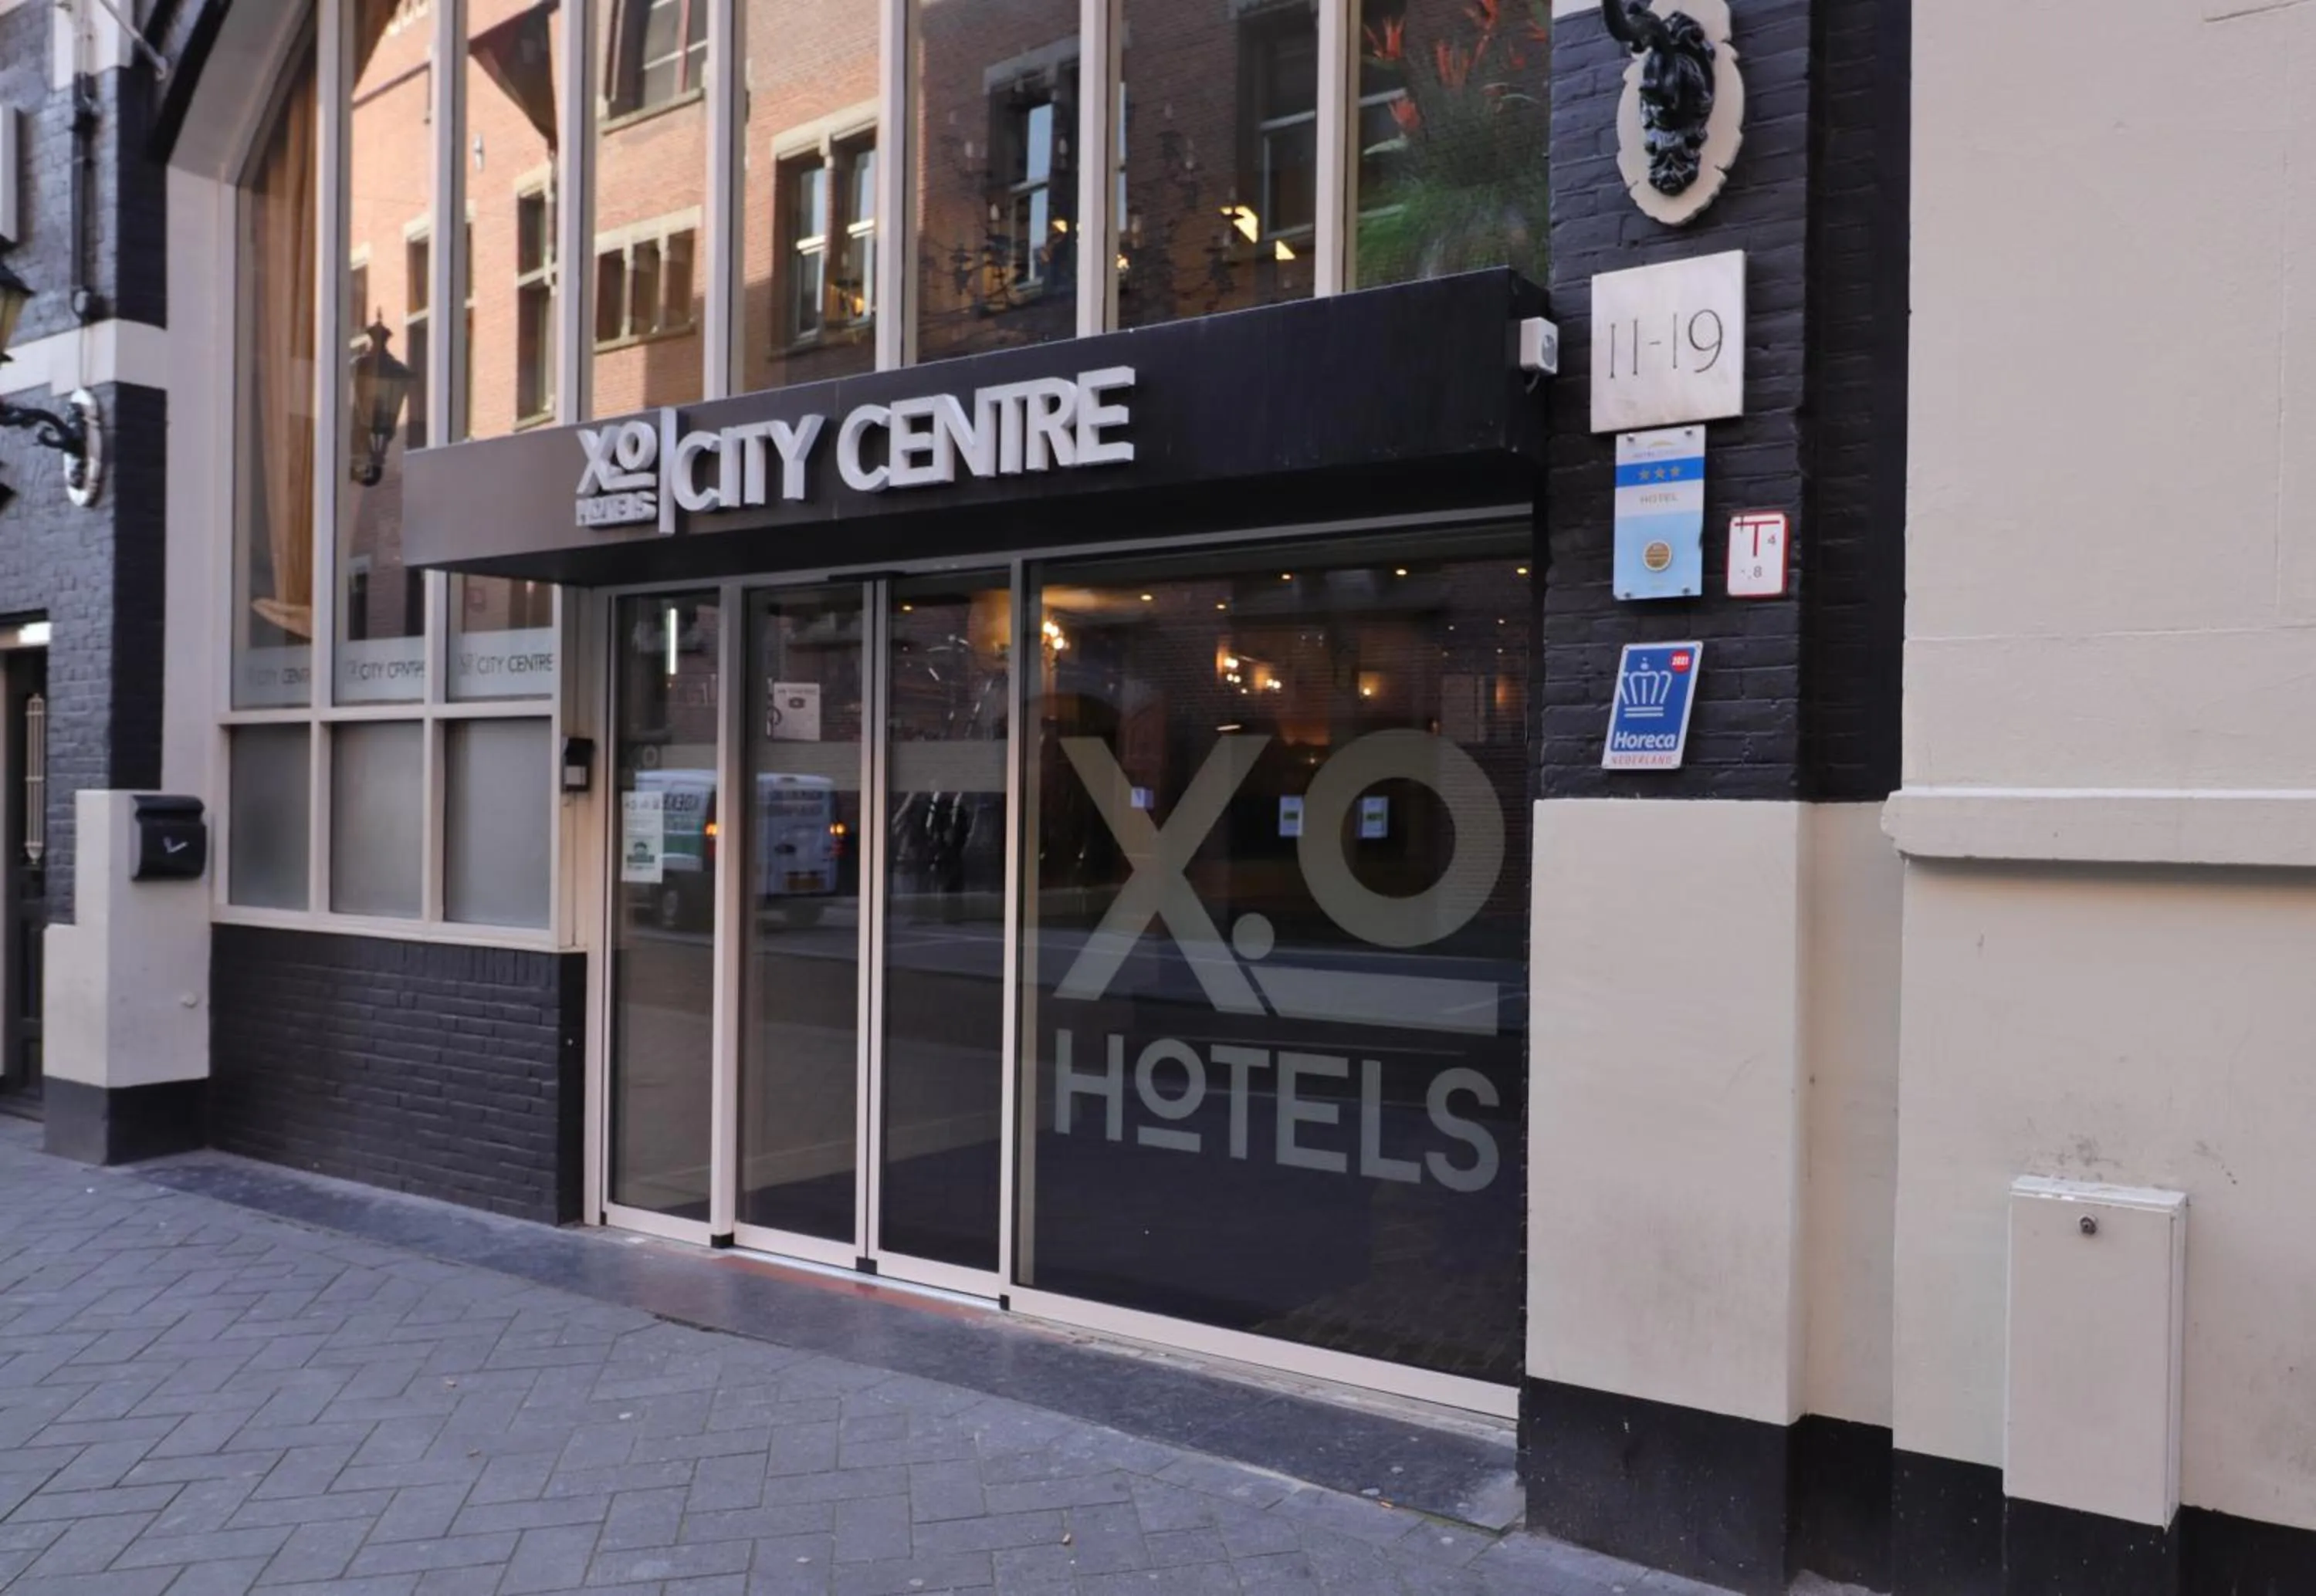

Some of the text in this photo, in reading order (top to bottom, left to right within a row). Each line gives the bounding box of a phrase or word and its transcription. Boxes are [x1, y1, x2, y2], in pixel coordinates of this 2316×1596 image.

[1609, 308, 1723, 379] 11-19
[671, 365, 1135, 512] CITY CENTRE
[1639, 492, 1679, 506] HOTEL
[1766, 533, 1776, 545] 4
[1752, 565, 1762, 579] 8
[476, 654, 506, 675] CITY
[506, 653, 554, 673] CENTRE
[1613, 731, 1677, 749] Horeca
[1611, 755, 1674, 765] NEDERLAND
[1053, 1028, 1500, 1193] HOTELS
